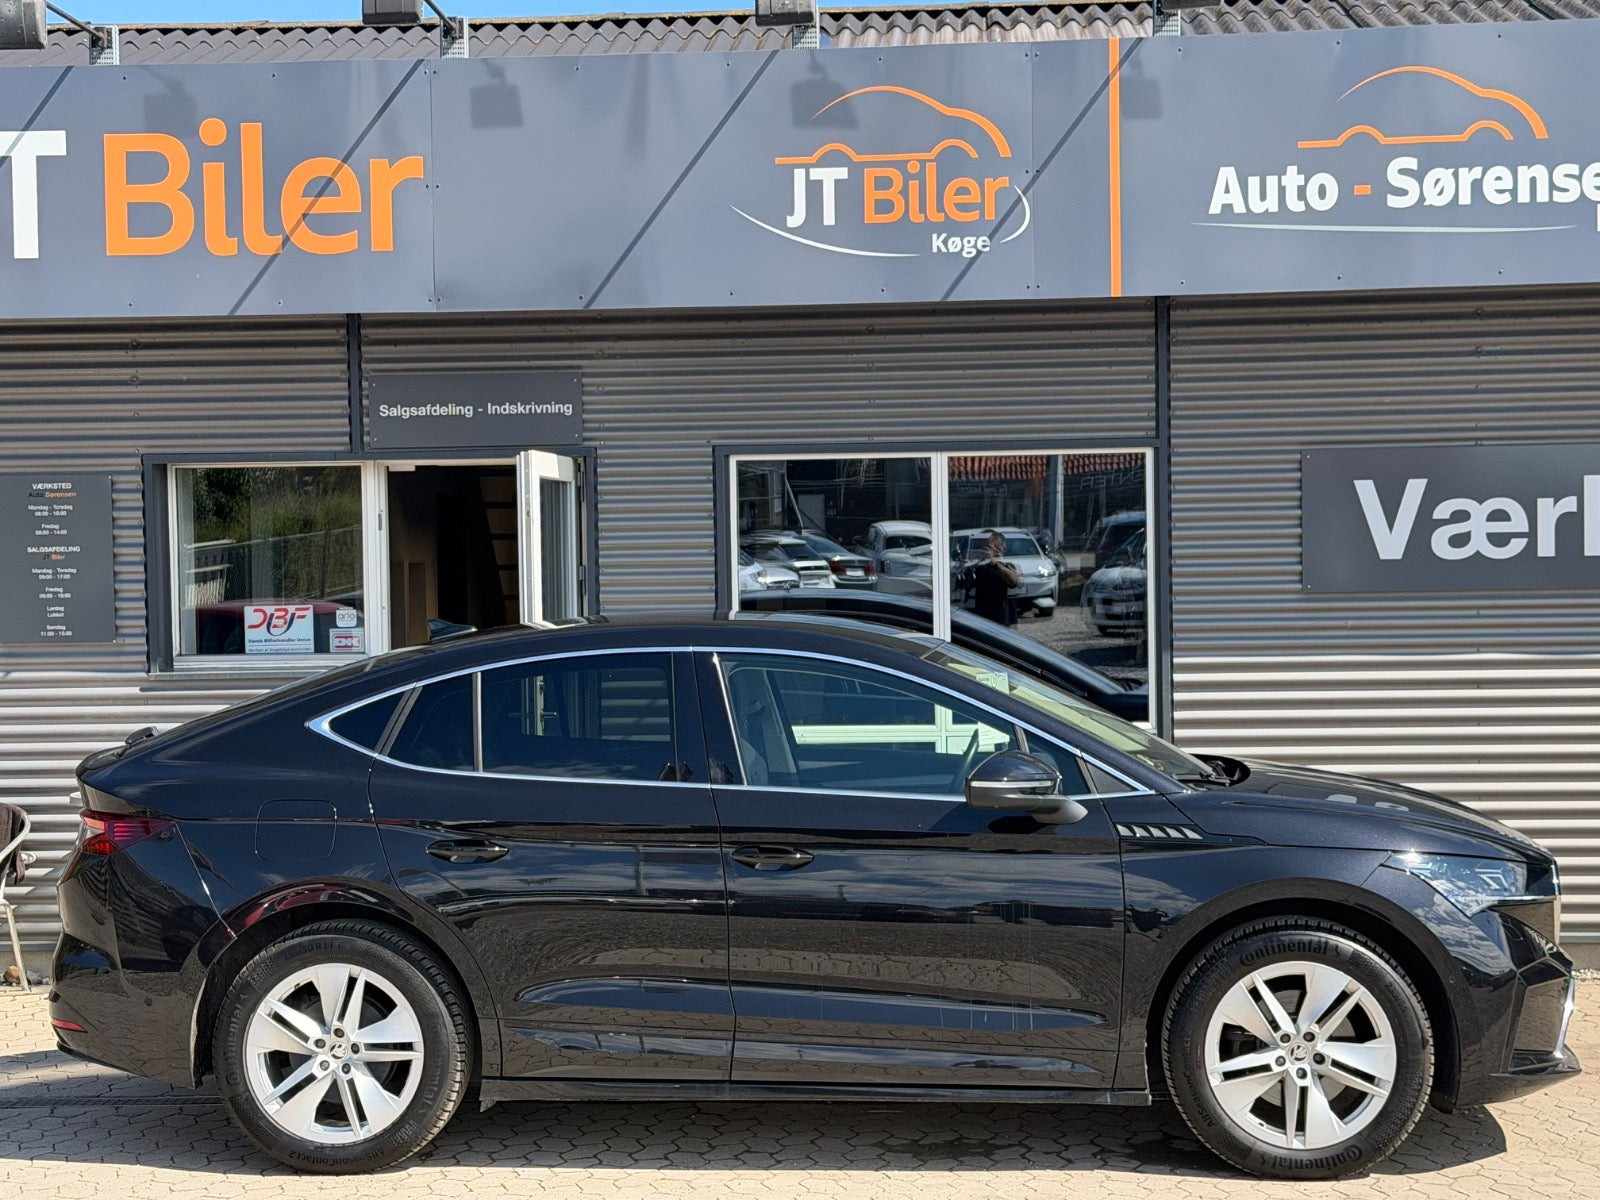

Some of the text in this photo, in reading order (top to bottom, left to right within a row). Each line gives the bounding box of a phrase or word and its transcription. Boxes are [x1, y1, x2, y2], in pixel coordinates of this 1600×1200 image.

[103, 118, 424, 256] Biler
[786, 160, 1010, 228] JT Biler
[1207, 165, 1339, 215] Auto
[931, 233, 991, 258] Køge
[379, 403, 474, 419] Salgsafdeling
[487, 401, 573, 416] Indskrivning
[1239, 938, 1330, 967] Continental
[1271, 1147, 1363, 1172] Continental
